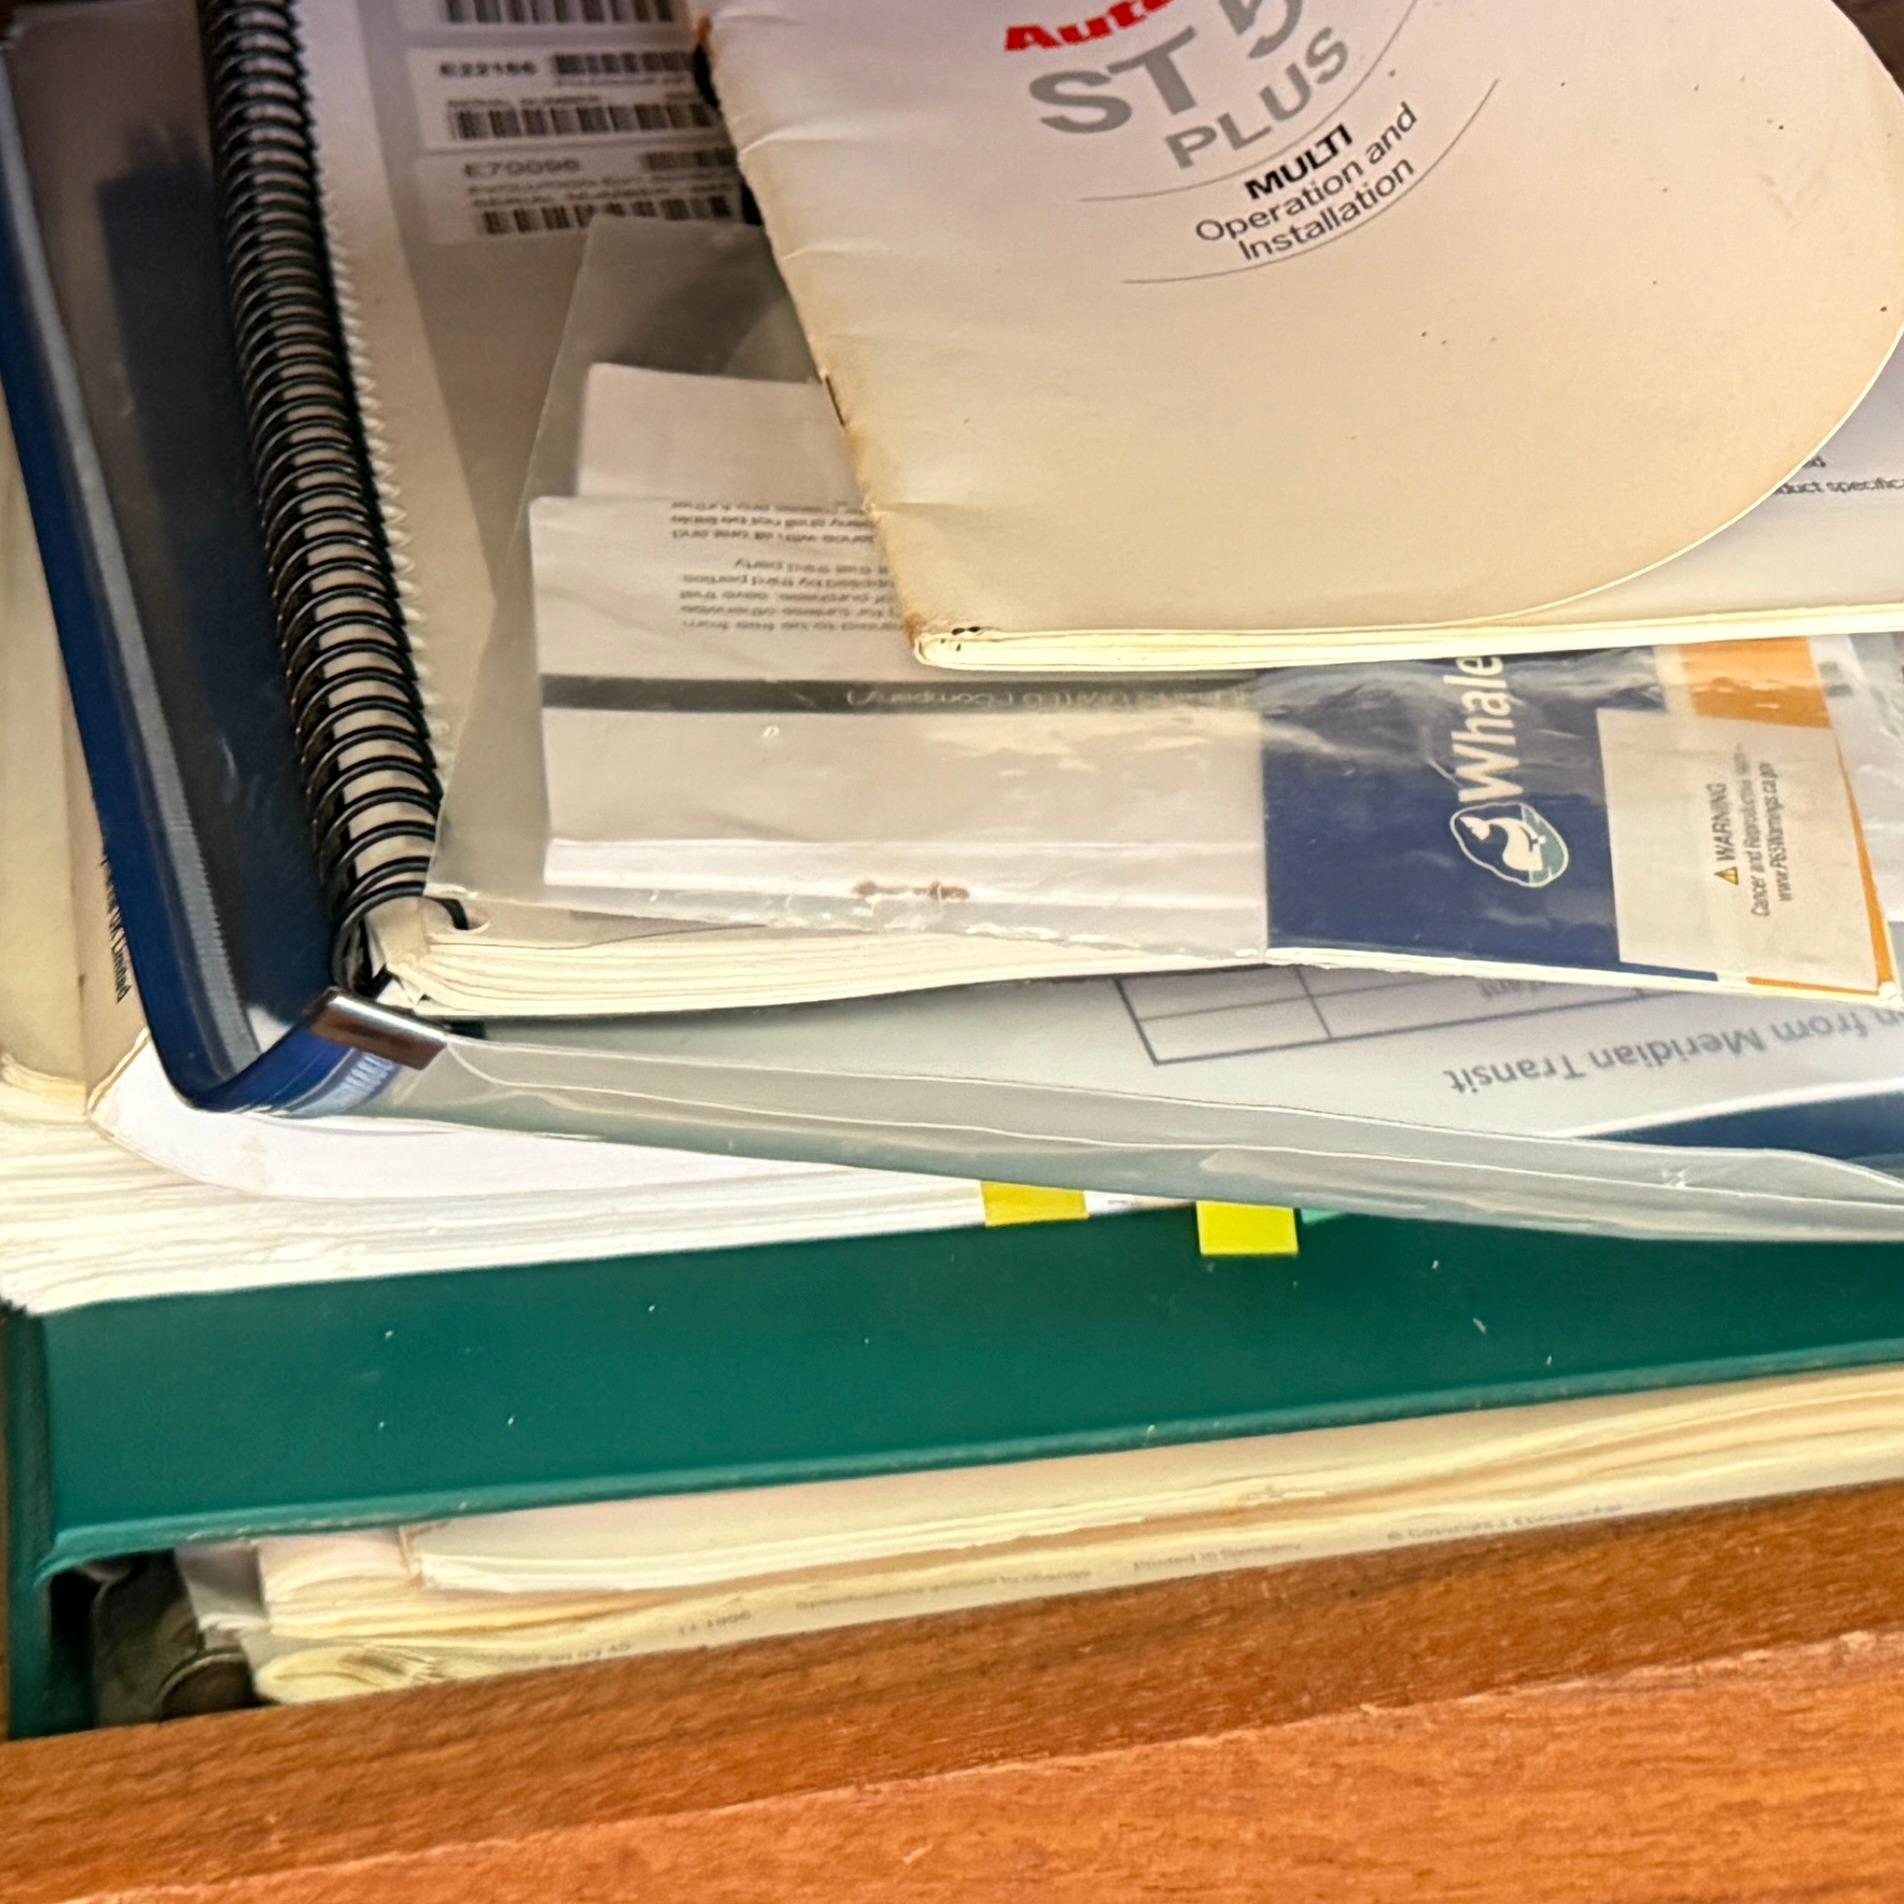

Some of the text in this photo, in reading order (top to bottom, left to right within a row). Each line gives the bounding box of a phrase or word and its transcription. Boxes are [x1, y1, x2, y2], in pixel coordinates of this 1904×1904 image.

[1028, 26, 1196, 133] ST
[1165, 26, 1348, 169] PLUS
[1196, 102, 1417, 241] Operation and
[1244, 124, 1353, 200] MULTI
[1237, 158, 1415, 261] Installation
[1444, 656, 1524, 802] Whale
[1706, 783, 1736, 861] WARNING
[1744, 851, 1764, 874] and
[1749, 875, 1770, 917] Cancer
[111, 939, 133, 1003] Limited
[1588, 1029, 1768, 1070] Meridian
[1772, 1010, 1873, 1045] from
[1442, 1045, 1586, 1094] Transit
